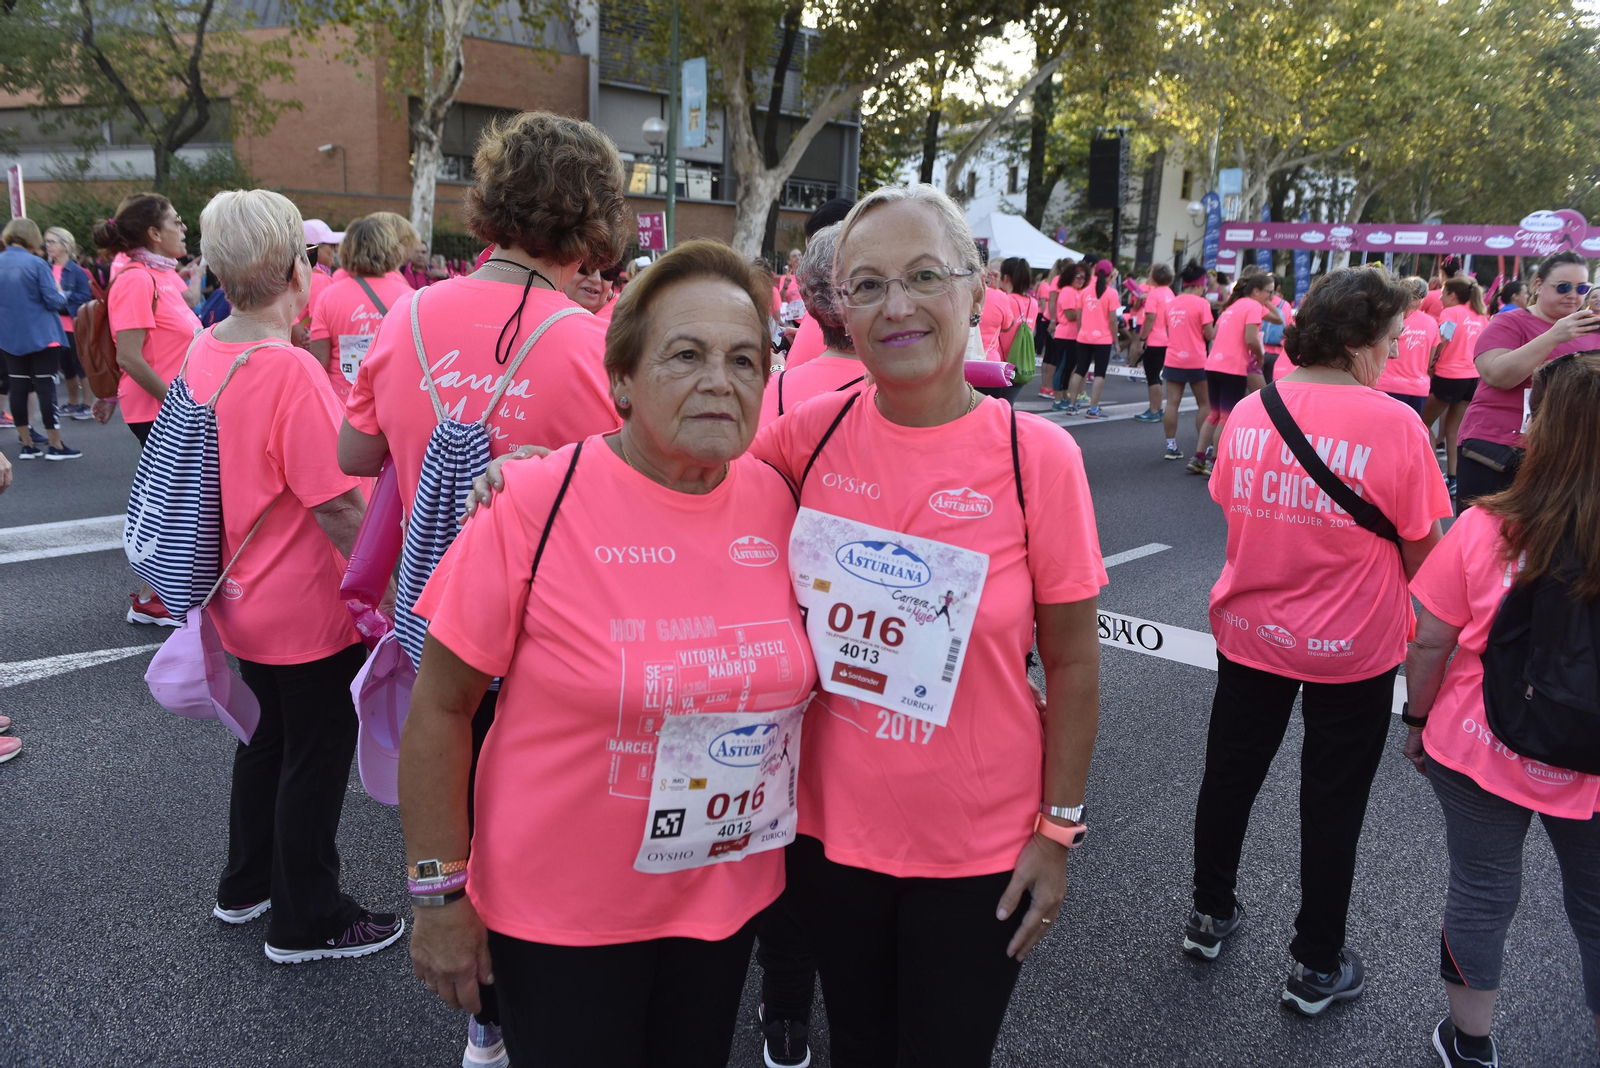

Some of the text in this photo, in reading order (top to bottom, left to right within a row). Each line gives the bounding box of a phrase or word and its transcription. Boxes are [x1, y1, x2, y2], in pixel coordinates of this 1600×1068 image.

[499, 402, 526, 420] de la
[822, 473, 881, 500] OYSHO
[1232, 466, 1254, 499] AS
[933, 495, 988, 513] ASTURIANA
[1256, 508, 1271, 518] DE
[1274, 511, 1284, 520] LA
[1286, 514, 1323, 527] MUJER
[595, 546, 676, 563] OYSHO
[733, 549, 776, 560] ASTURIANA
[842, 549, 922, 583] ASTURIANA
[892, 590, 929, 610] Carrera
[828, 603, 906, 647] 016
[909, 607, 937, 625] Mujer
[610, 619, 645, 642] HOY
[656, 616, 717, 641] GANAN
[679, 648, 728, 666] VITORIA
[739, 641, 786, 659] GASTEIZ
[839, 643, 879, 664] 4013
[1307, 637, 1354, 652] DKV
[708, 659, 757, 678] MADRID
[848, 671, 879, 686] Santander
[901, 696, 934, 713] ZURICH
[876, 710, 935, 745] 2019
[715, 735, 775, 758] ASTURI
[1524, 763, 1573, 781] ASTURIANA
[706, 781, 765, 820] 016
[718, 820, 752, 838] 4012
[761, 830, 787, 843] ZURICH
[647, 851, 693, 862] OYSHO
